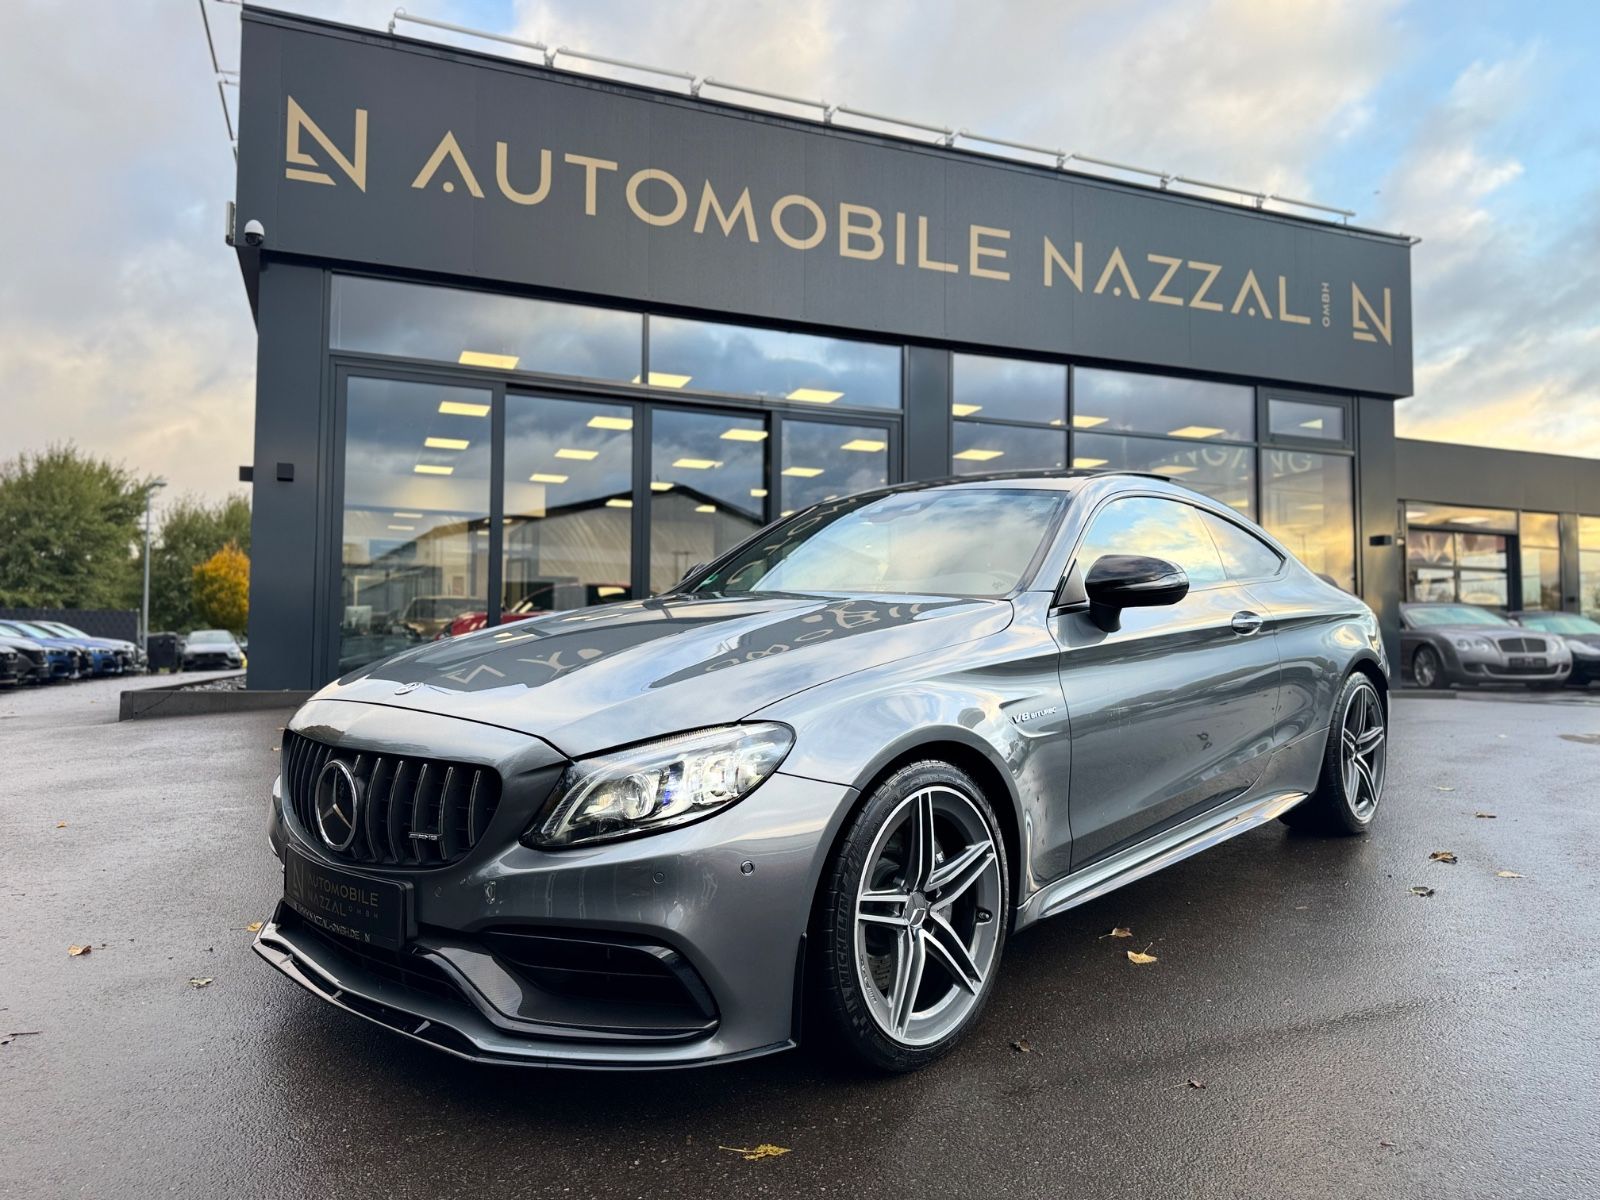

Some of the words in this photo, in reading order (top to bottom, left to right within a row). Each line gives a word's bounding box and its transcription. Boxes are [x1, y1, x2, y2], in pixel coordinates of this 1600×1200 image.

[411, 130, 1011, 281] AUTOMOBILE
[1043, 236, 1312, 325] NAZZAL
[1012, 711, 1030, 724] V8
[306, 874, 379, 908] AUTOMOBILE
[837, 893, 851, 988] MICHELIN
